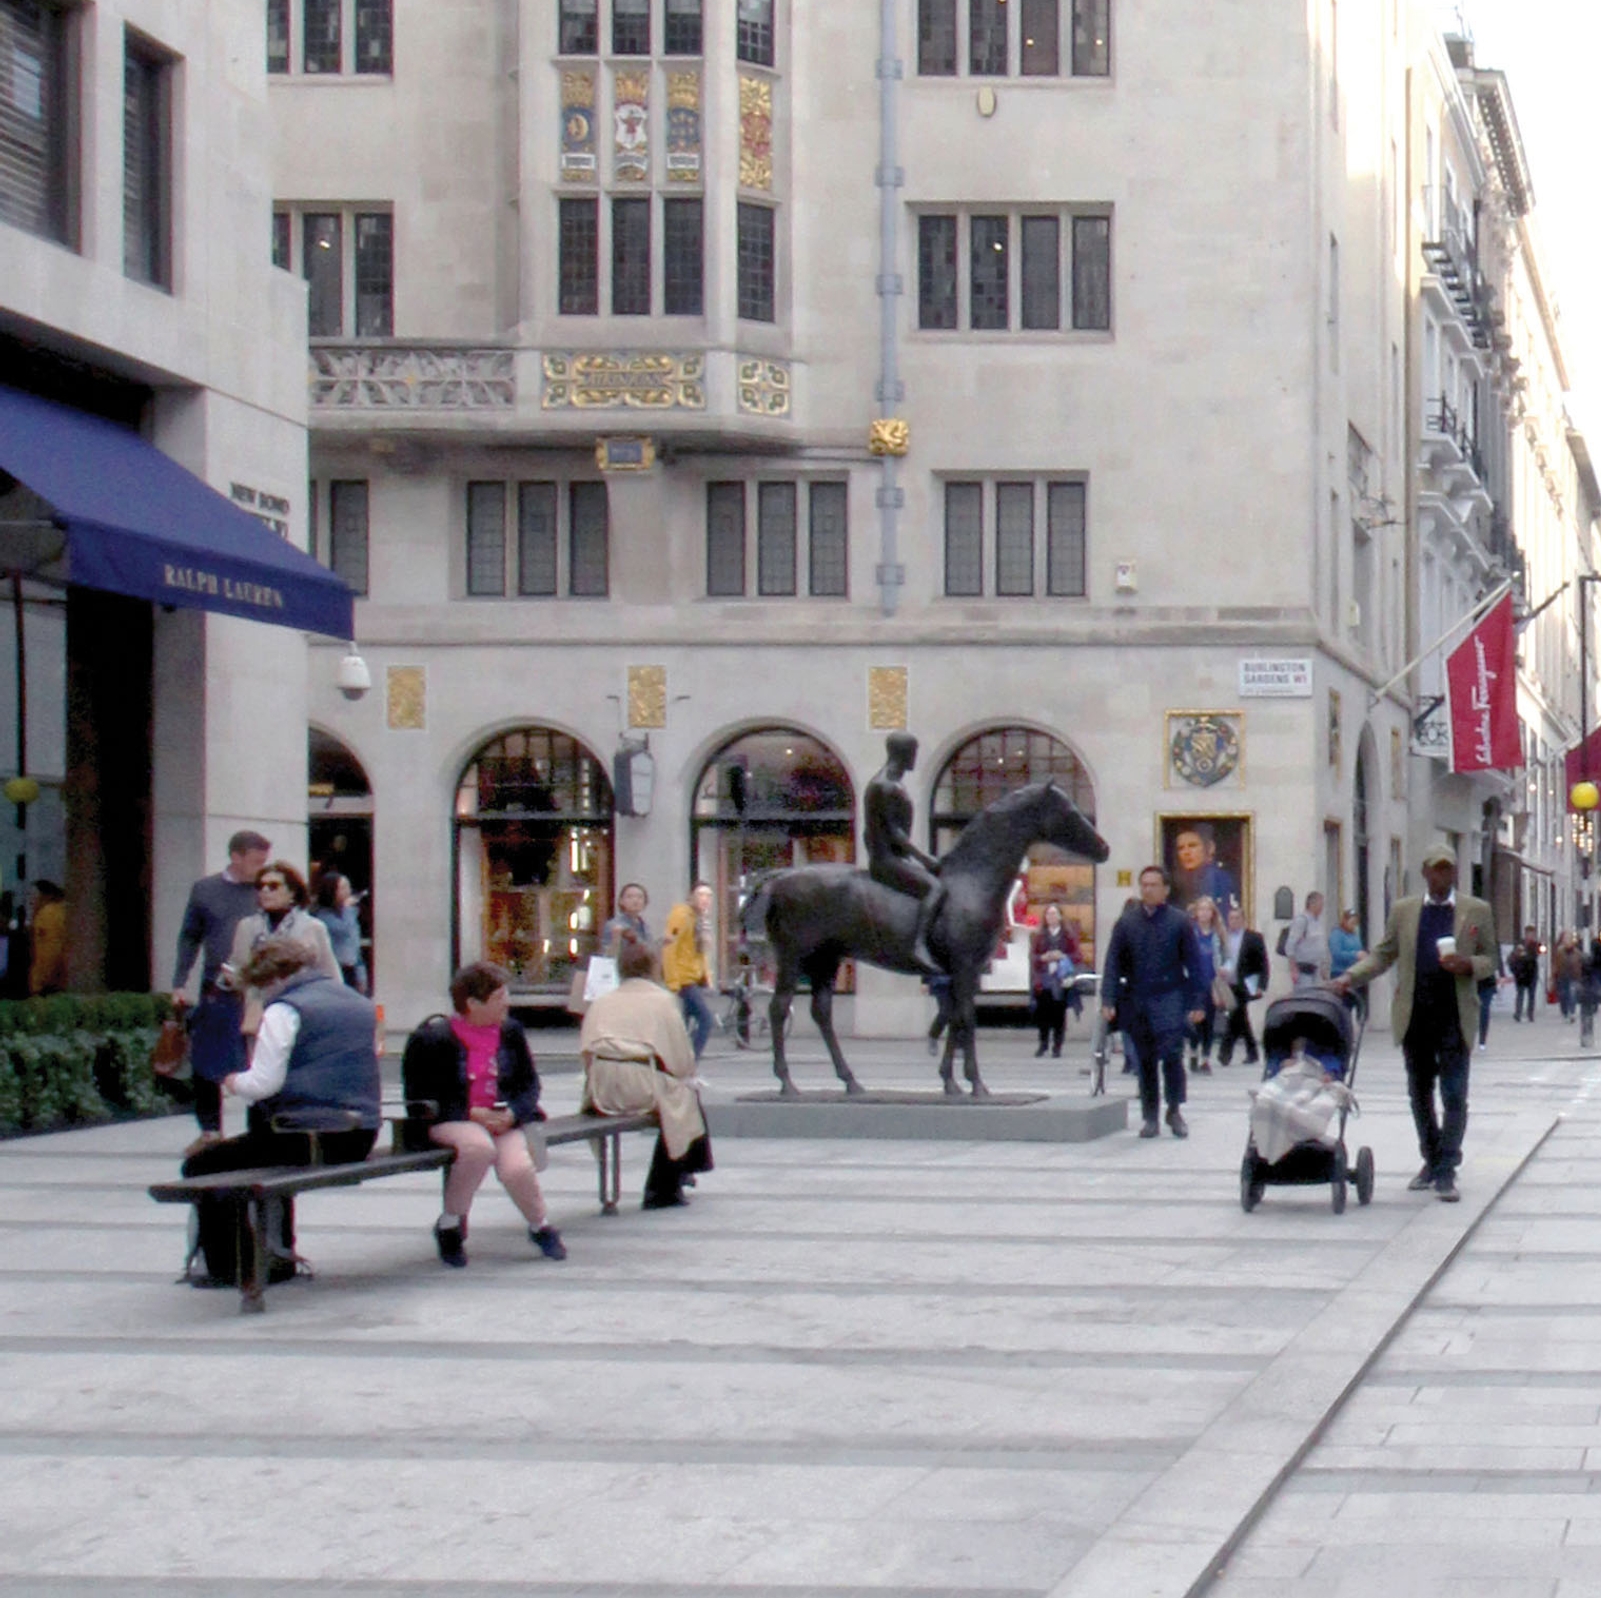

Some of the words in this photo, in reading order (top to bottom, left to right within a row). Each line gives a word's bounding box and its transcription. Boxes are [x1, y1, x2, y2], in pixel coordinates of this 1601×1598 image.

[164, 563, 219, 595] RALPH
[223, 577, 284, 610] LAUREN
[1244, 662, 1306, 673] BURLINGTON
[1244, 673, 1290, 683] GARDENS
